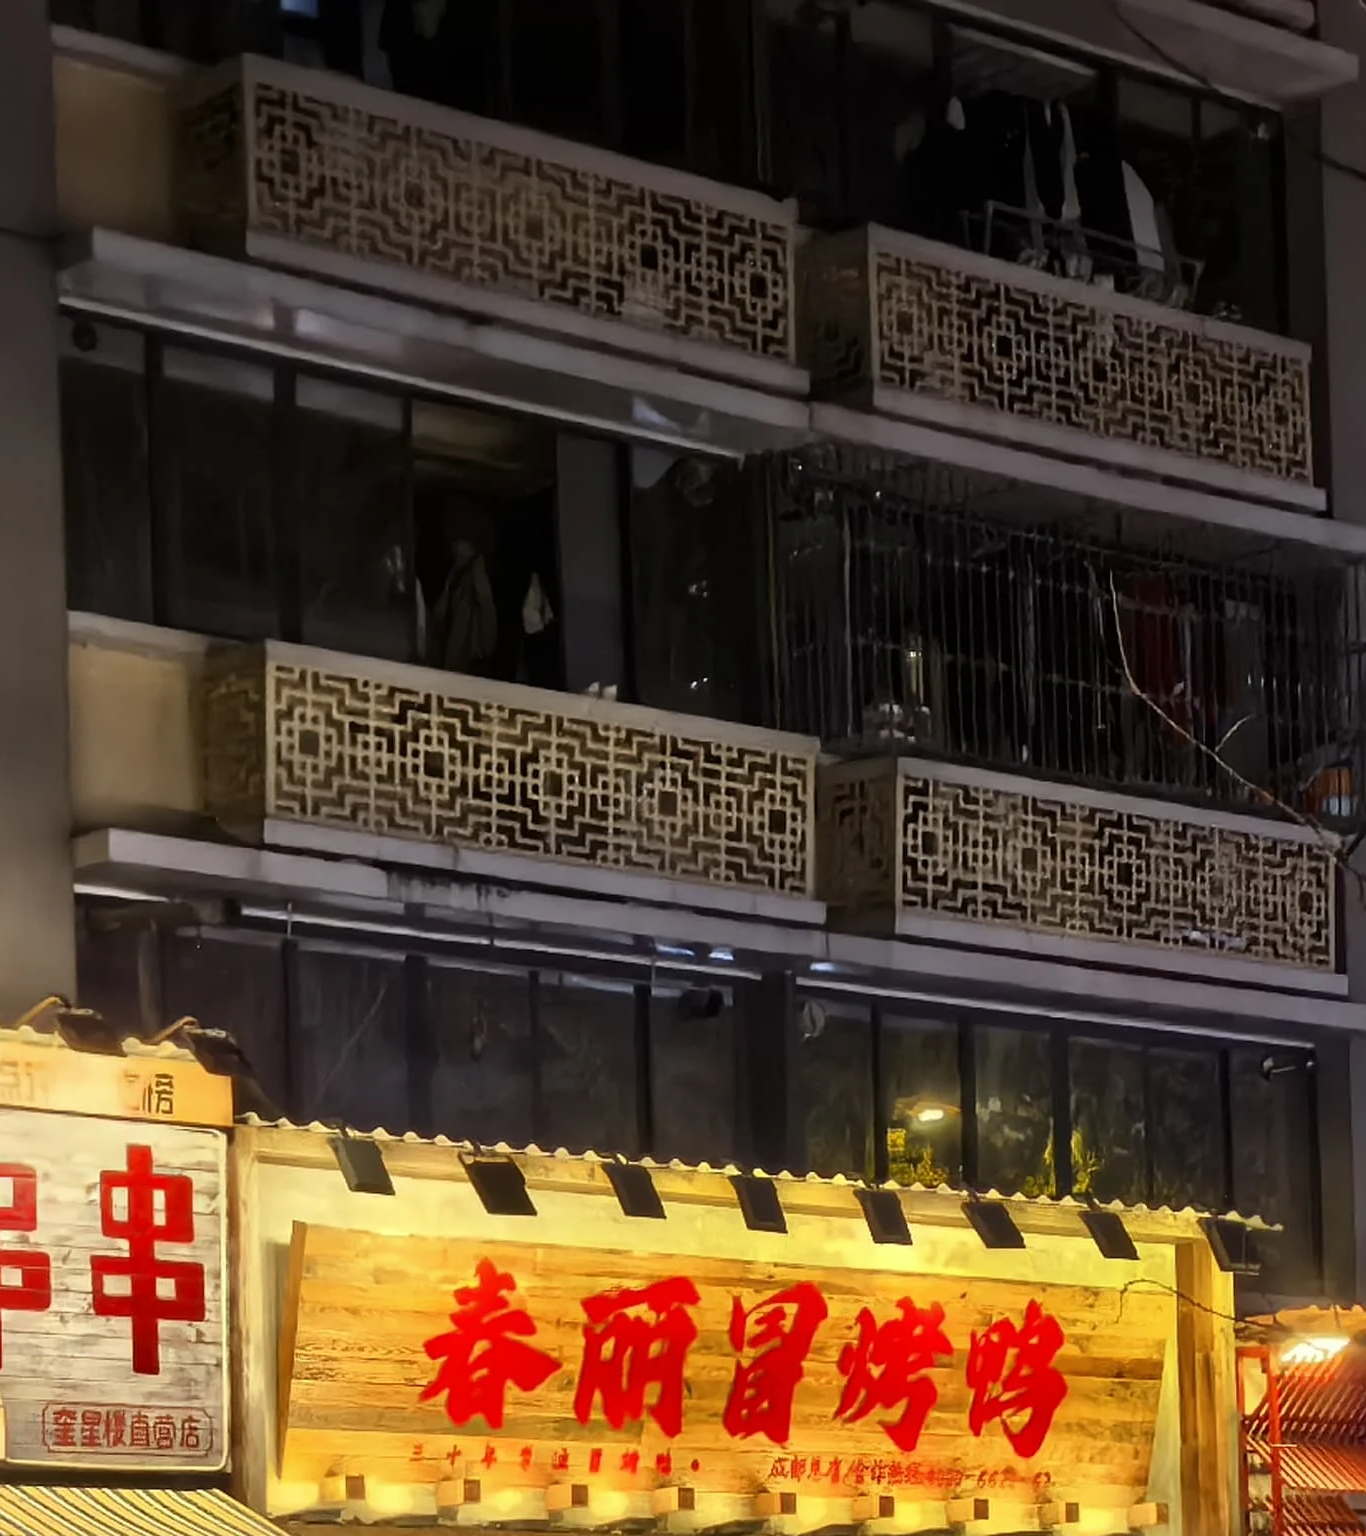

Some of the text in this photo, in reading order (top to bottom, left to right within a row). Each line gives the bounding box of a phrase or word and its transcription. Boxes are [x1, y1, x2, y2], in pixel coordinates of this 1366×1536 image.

[419, 1255, 1068, 1459] 春丽冒烤鸭
